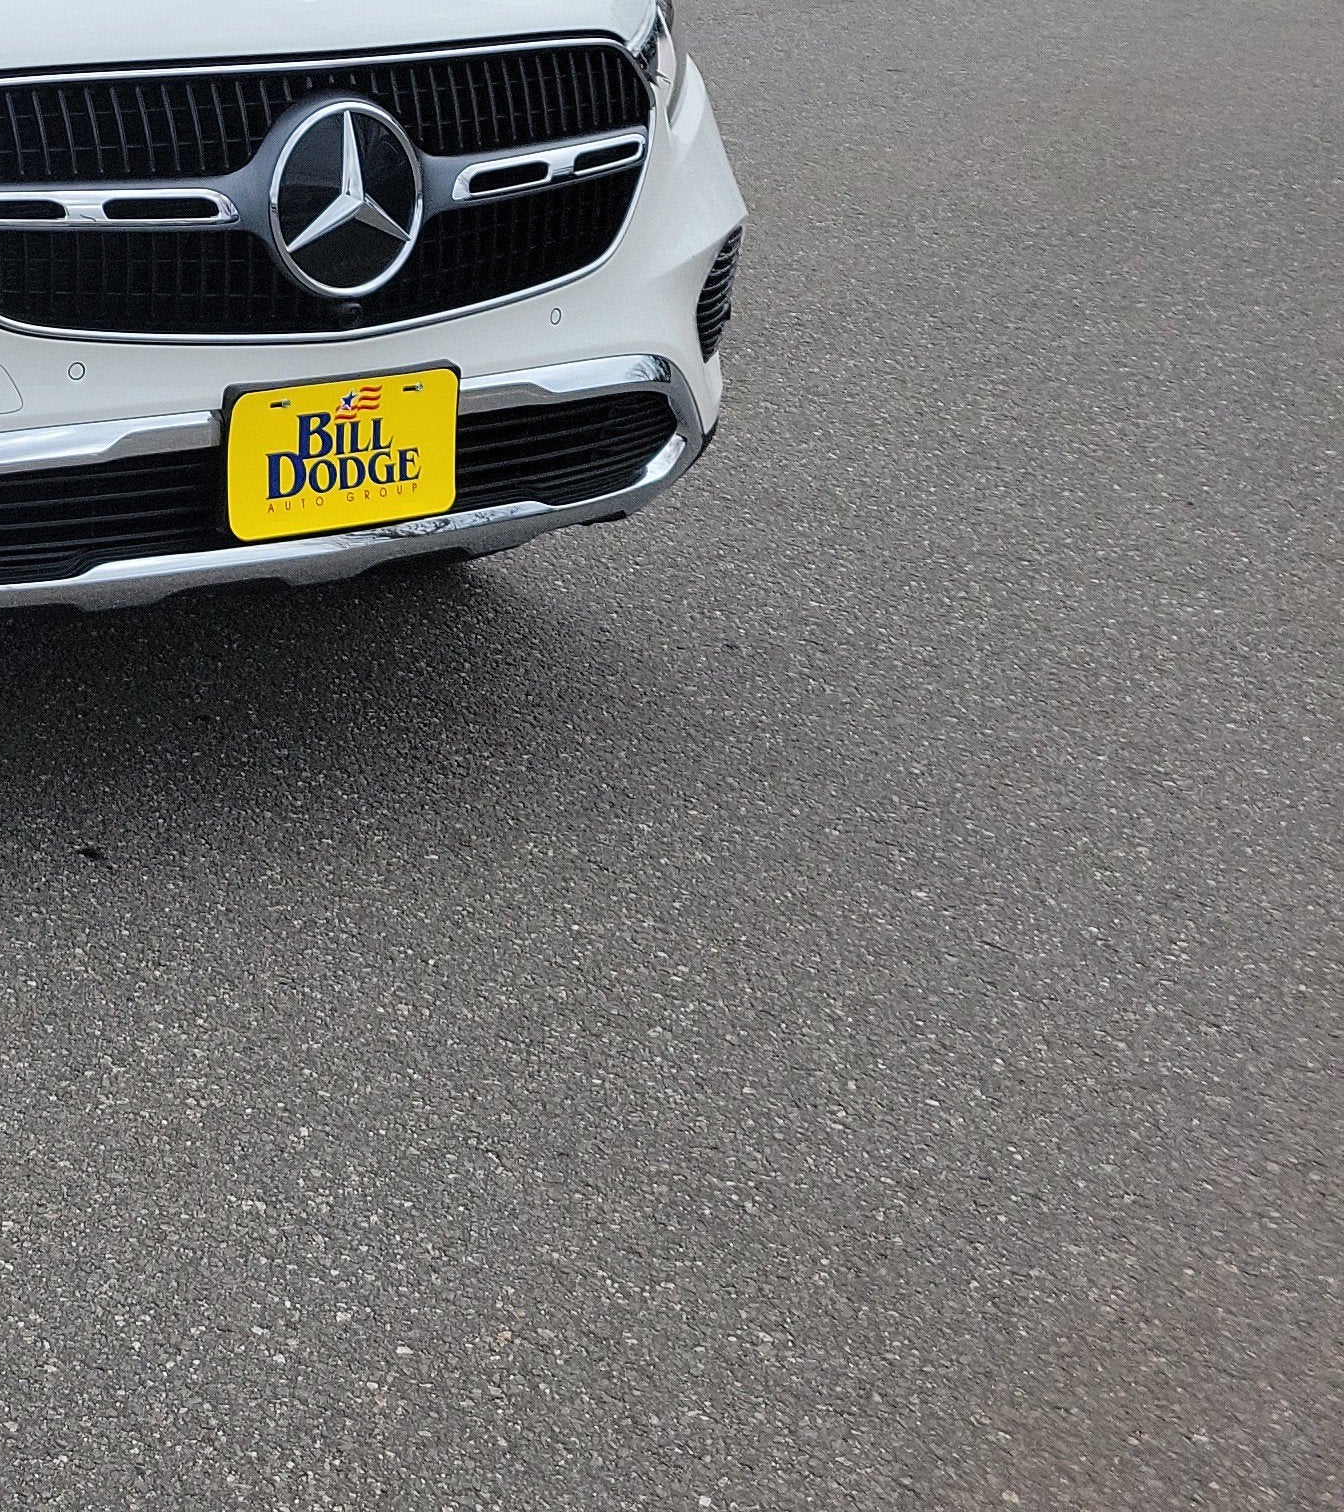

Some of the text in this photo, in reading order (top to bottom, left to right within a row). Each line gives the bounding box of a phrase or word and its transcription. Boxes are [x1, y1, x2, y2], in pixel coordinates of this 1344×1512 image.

[296, 411, 394, 460] BILL
[265, 447, 422, 501] DODGE
[267, 482, 418, 514] AUTO GROUP
